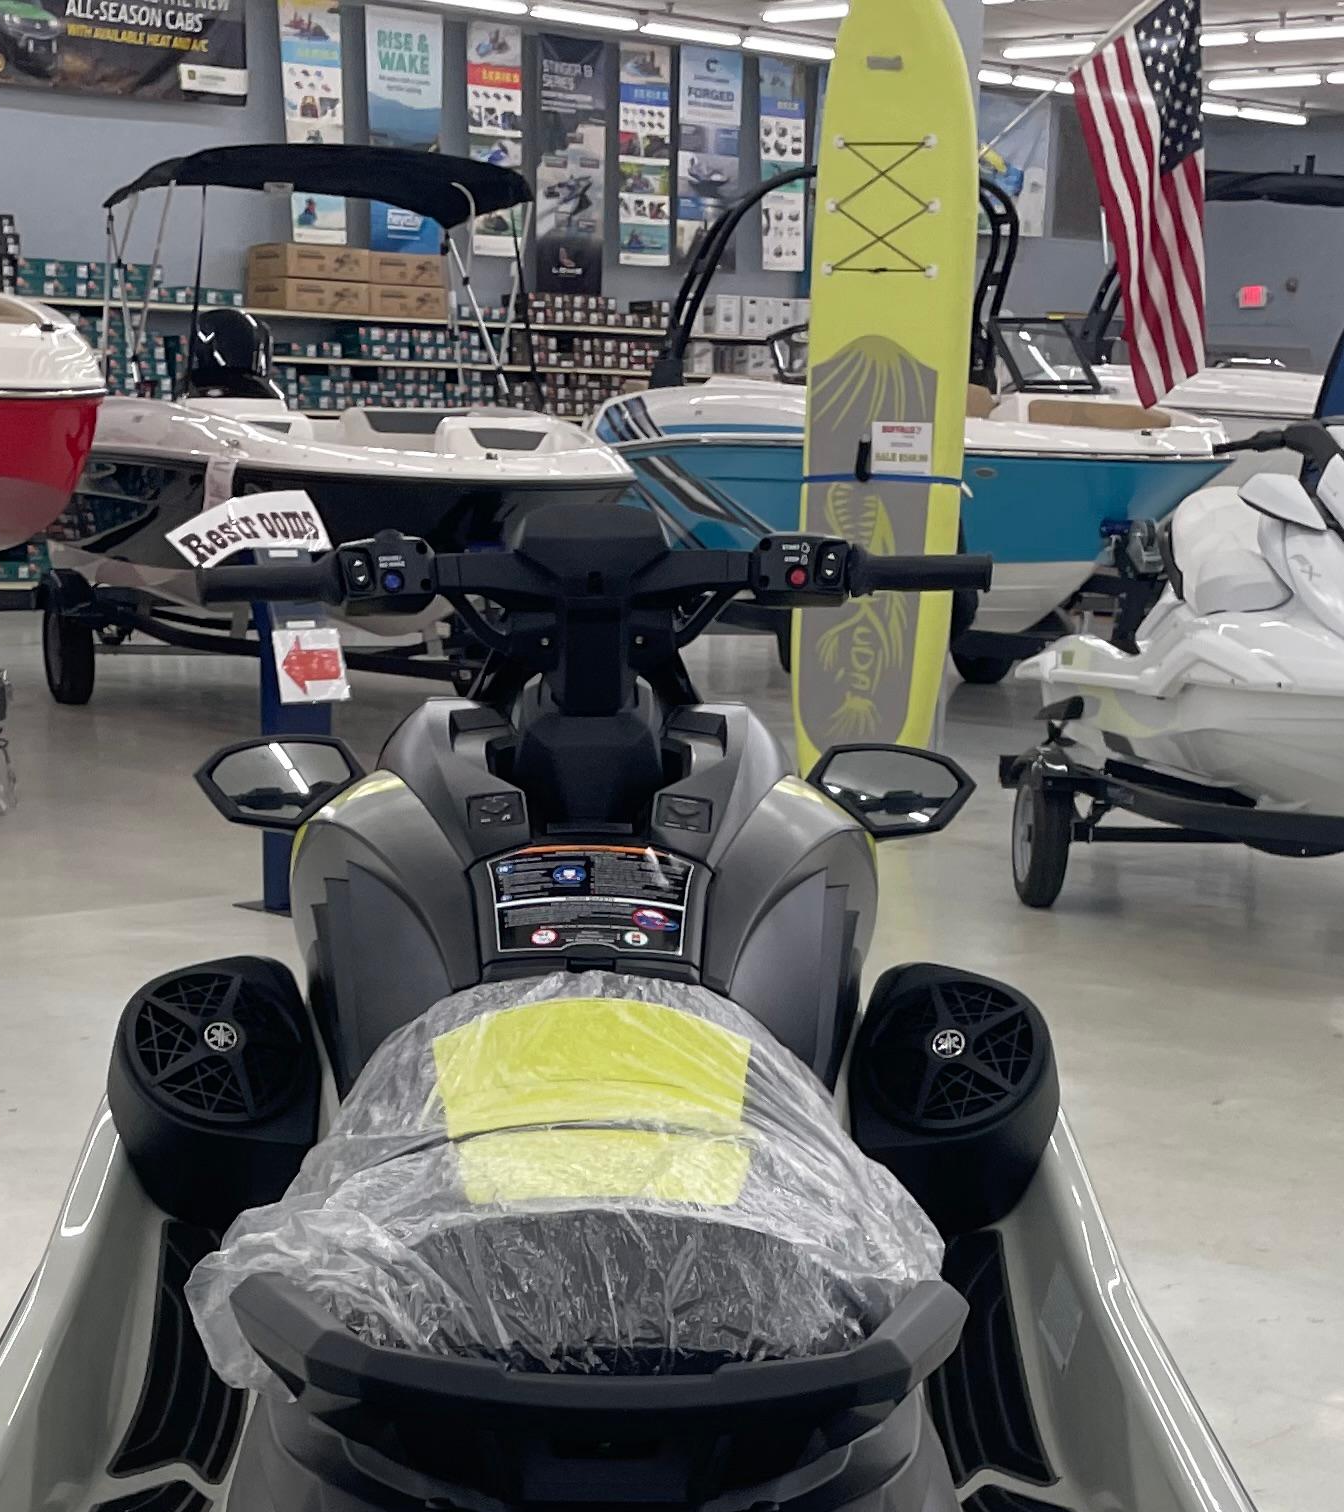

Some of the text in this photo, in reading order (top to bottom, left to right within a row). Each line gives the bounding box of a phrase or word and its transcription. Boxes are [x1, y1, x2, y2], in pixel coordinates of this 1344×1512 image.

[65, 0, 204, 33] ALL-SEASON CABS
[93, 27, 145, 45] AVAILABLE
[377, 29, 429, 53] RISE &
[378, 50, 430, 75] WAKE
